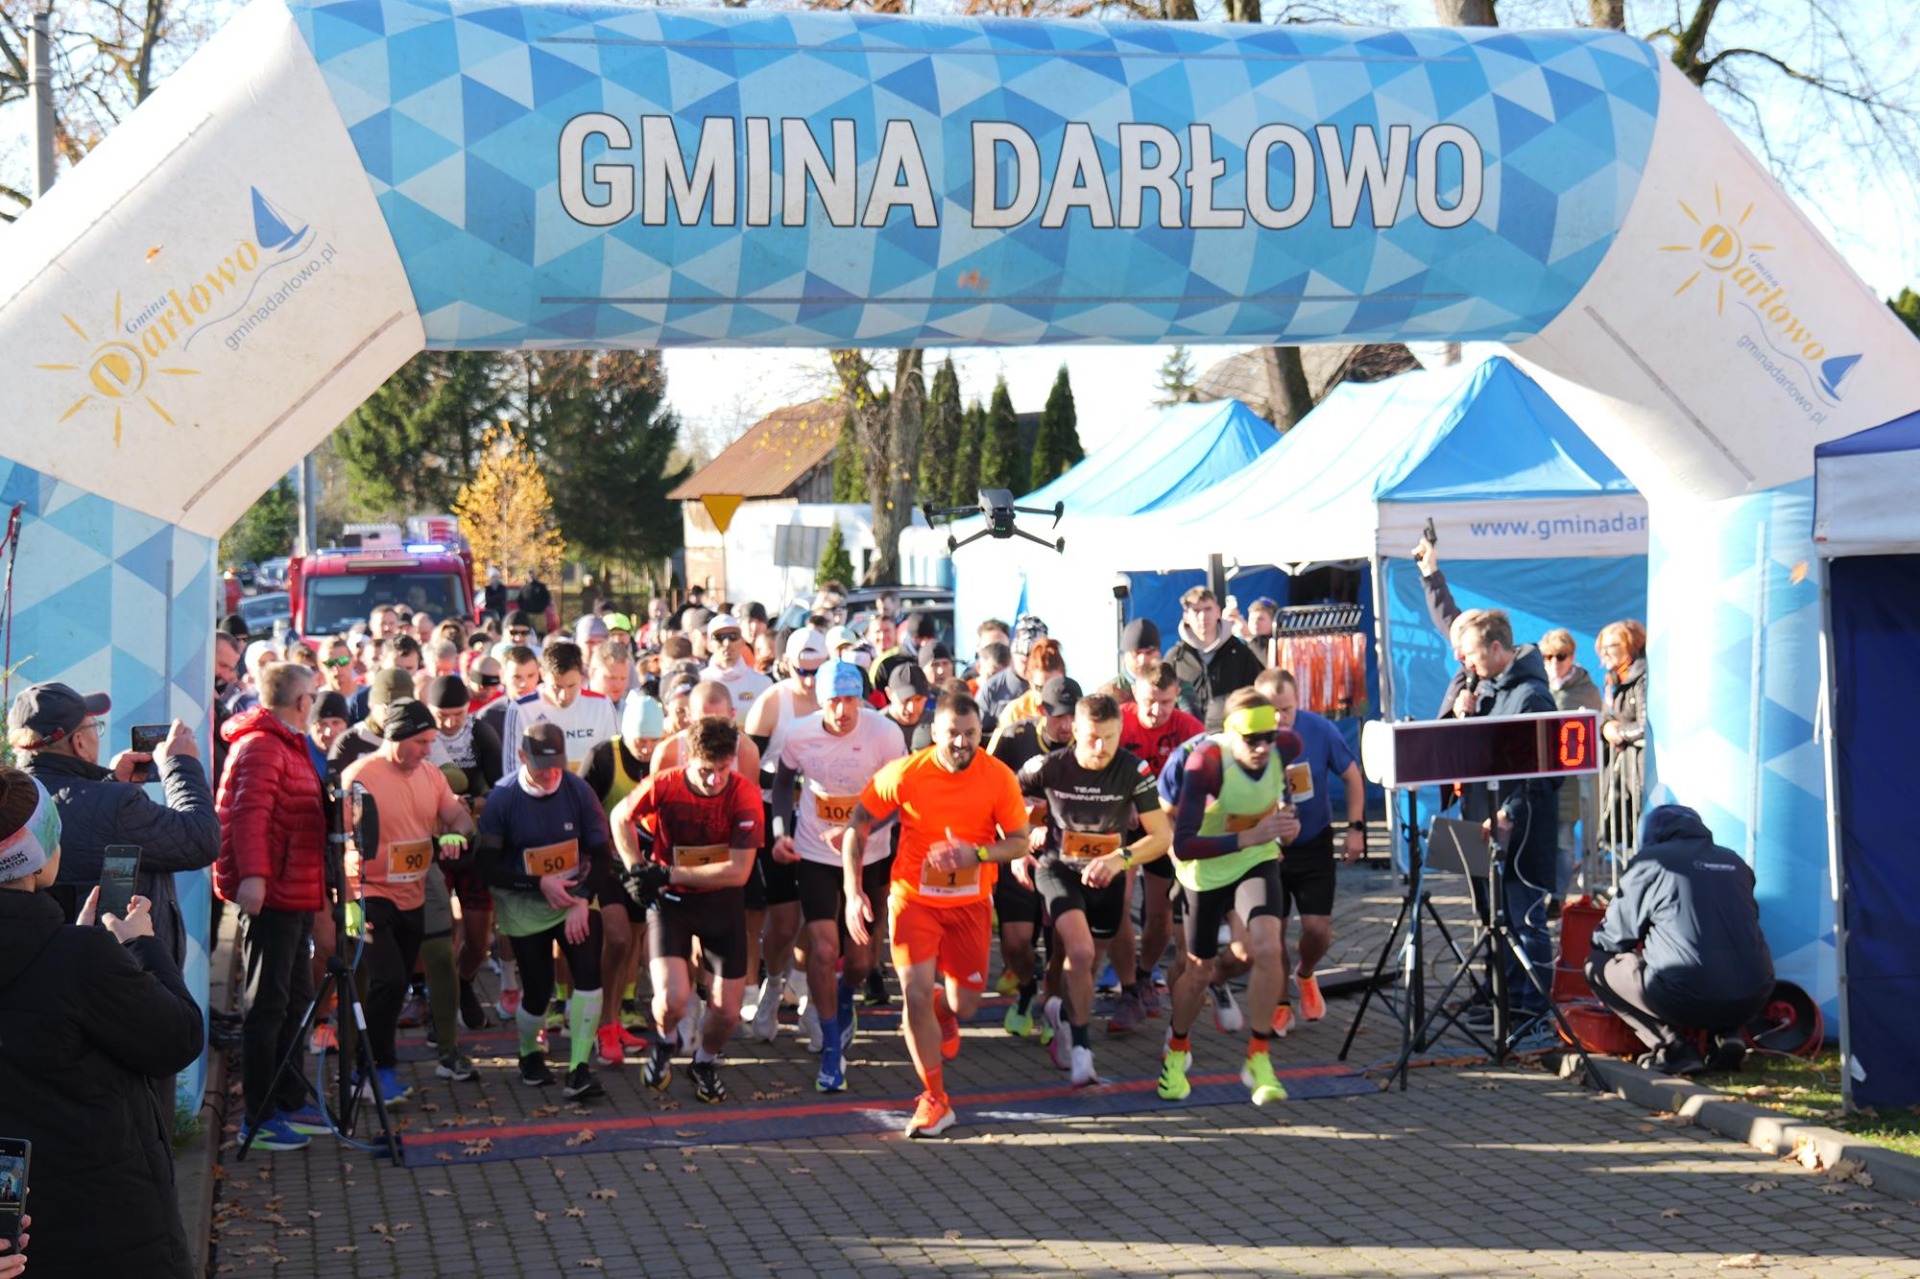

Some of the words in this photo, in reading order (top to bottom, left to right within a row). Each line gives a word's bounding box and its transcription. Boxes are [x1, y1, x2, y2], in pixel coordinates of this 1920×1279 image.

[558, 112, 939, 228] GMINA
[970, 120, 1484, 230] DARŁOWO
[1749, 253, 1779, 287] Gmina
[124, 295, 168, 334] Gmina
[225, 242, 338, 351] gminadarlowo.pl
[1737, 334, 1828, 425] gminadarlowo.pl
[1560, 720, 1586, 767] 0
[405, 853, 423, 870] 90
[543, 856, 565, 874] 50
[1080, 844, 1102, 856] 45
[948, 872, 956, 887] 1
